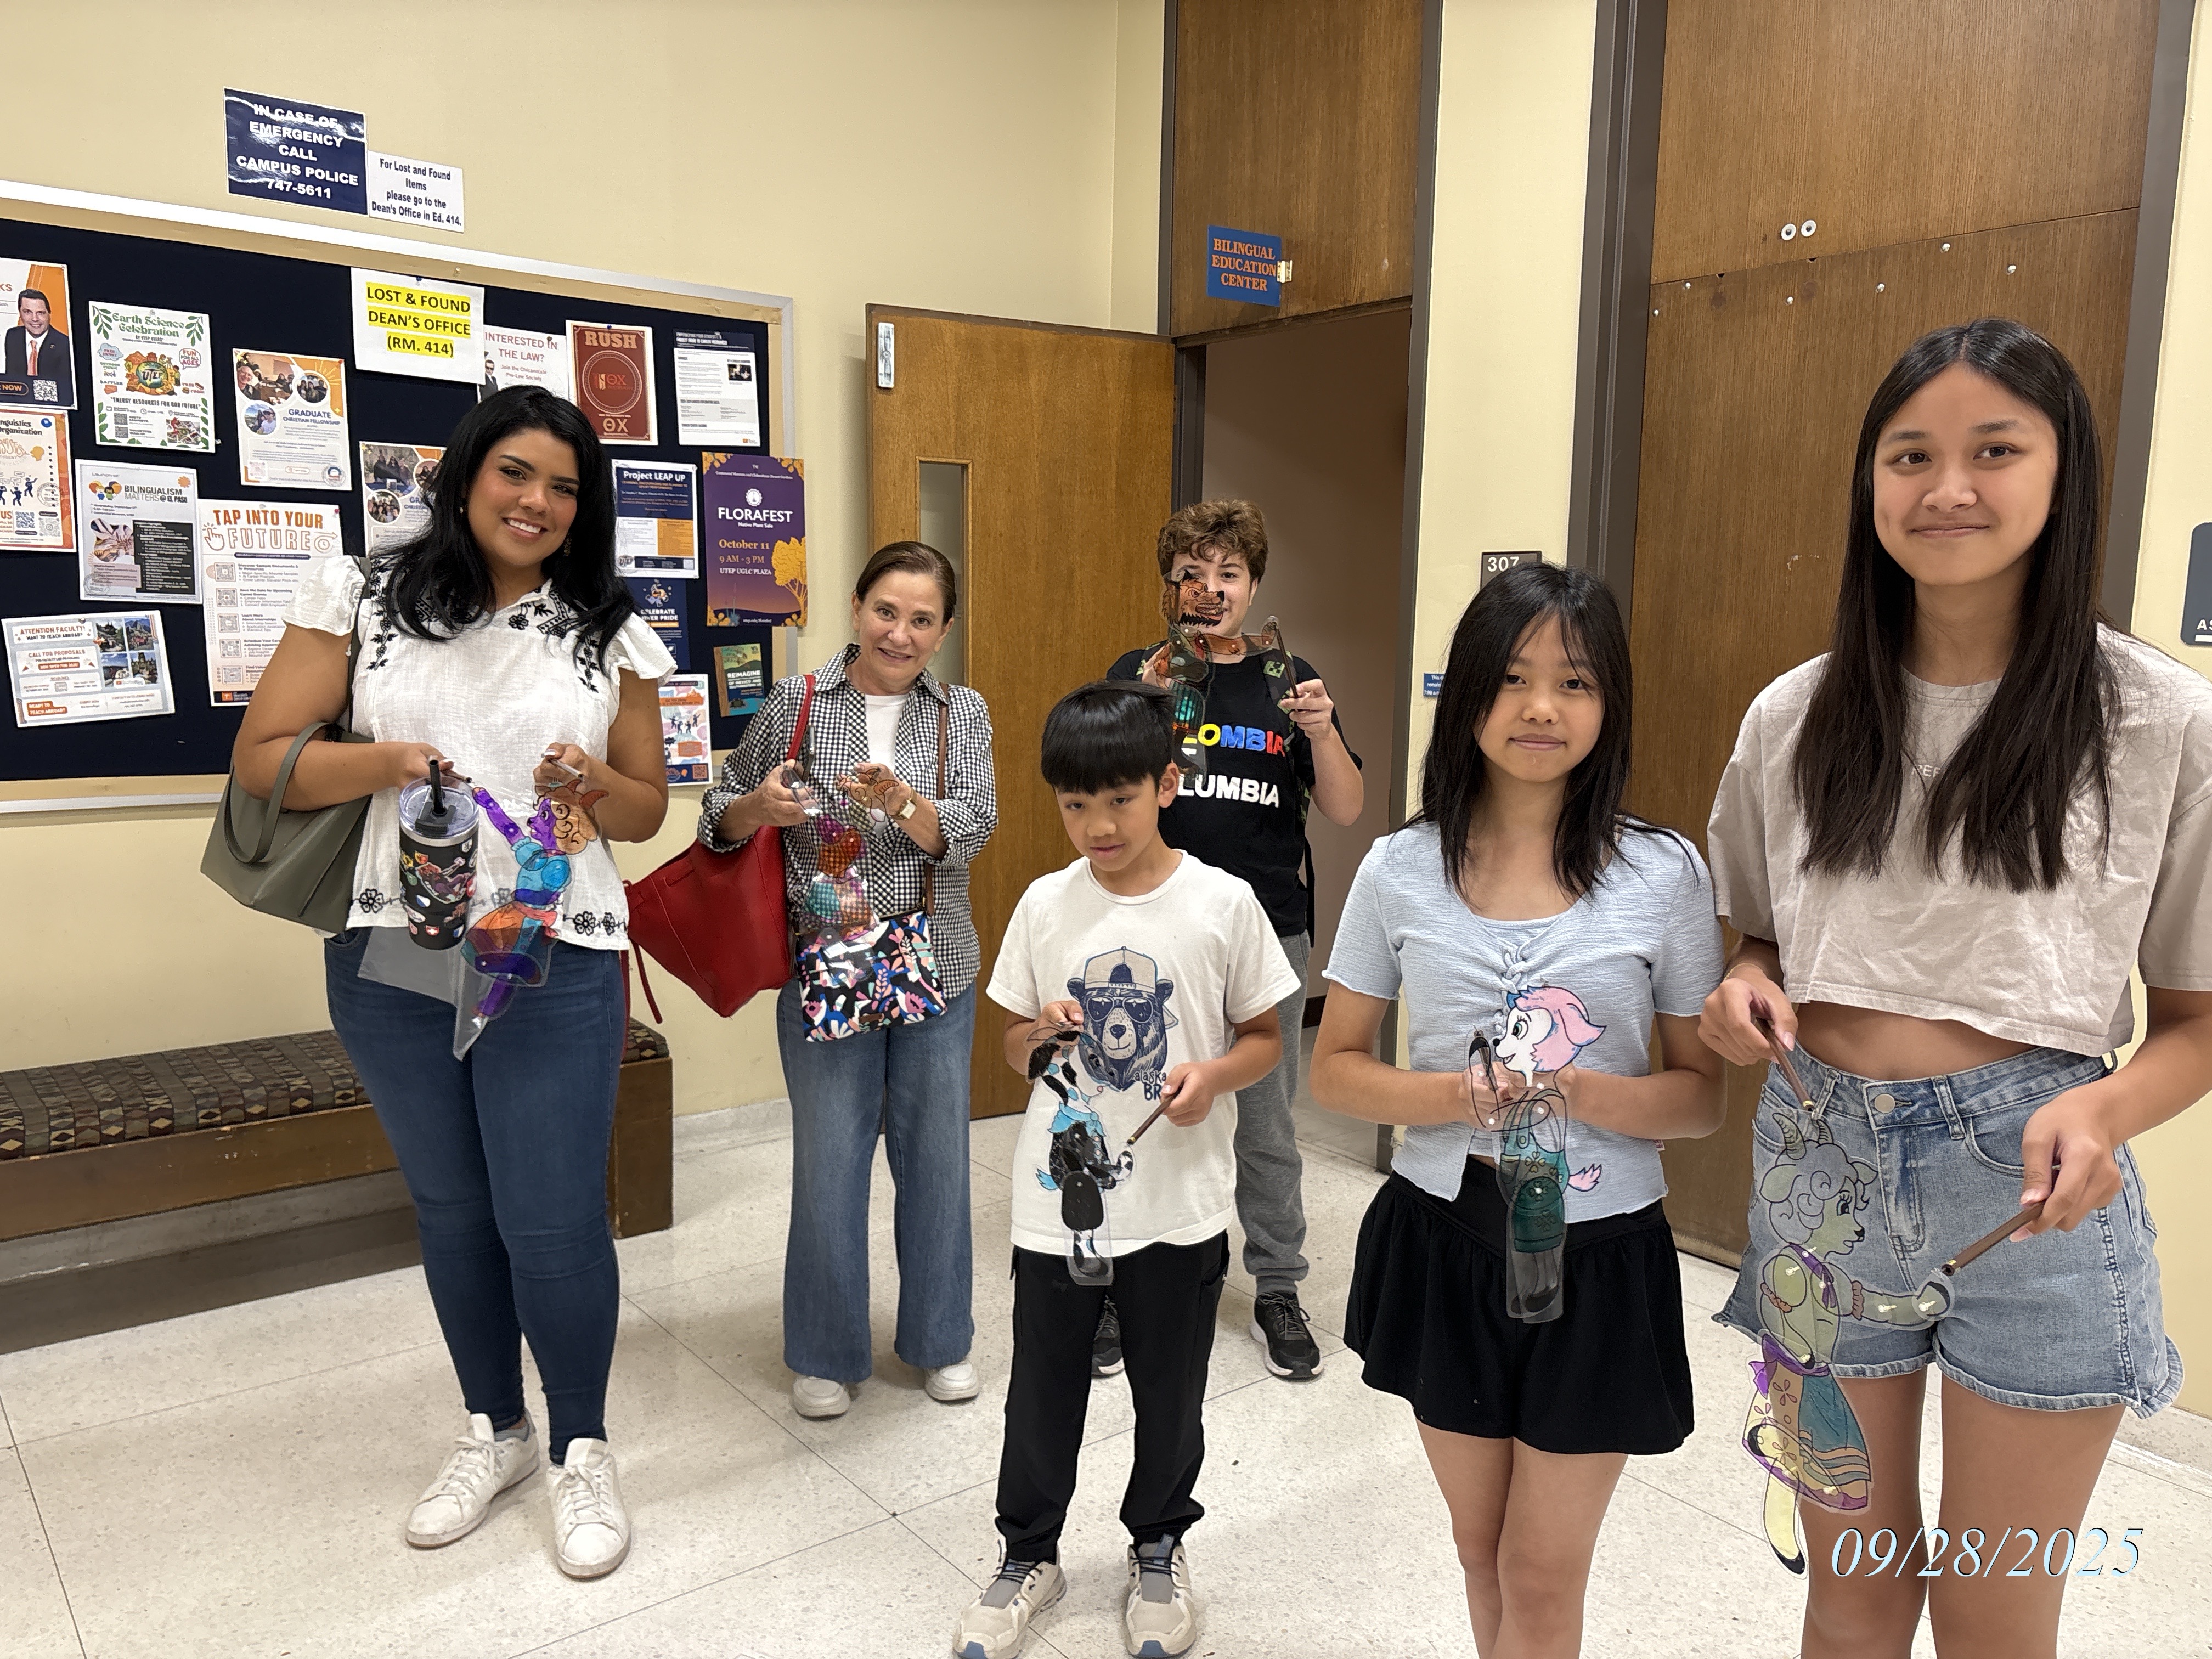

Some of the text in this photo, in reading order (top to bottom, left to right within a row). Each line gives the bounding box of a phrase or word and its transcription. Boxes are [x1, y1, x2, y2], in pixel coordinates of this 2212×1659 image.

[254, 104, 338, 128] IN CASE OF
[249, 121, 343, 148] EMERGENCY
[278, 145, 318, 161] CALL
[236, 155, 358, 186] CAMPUS POLICE
[380, 158, 451, 180] For Lost and Found
[267, 179, 331, 199] 747-5611
[405, 178, 427, 190] Items
[386, 190, 447, 208] please go to the
[371, 201, 462, 226] Dean's Office in Ed. 414.
[1213, 238, 1276, 261] BILINGUAL
[1211, 254, 1277, 277] EDUCATION
[1221, 273, 1268, 292] CENTER
[367, 286, 470, 313] LOST & FOUND
[112, 312, 185, 329] Earth Science
[369, 311, 471, 336] DEAN’S OFFICE
[119, 323, 179, 337] Celebration
[387, 335, 454, 358] (RM. 414)
[485, 331, 558, 351] INTERESTED IN
[584, 330, 637, 349] RUSH
[498, 348, 545, 363] THE LAW?
[132, 398, 160, 407] RESOURCES
[288, 409, 331, 419] GRADUATE
[623, 471, 686, 482] Project LEAP UP
[124, 485, 183, 495] BILINGUALISM
[0, 510, 12, 519] US
[212, 509, 323, 529] TAP INTO YOUR
[718, 507, 793, 523] FLORAFEST
[228, 528, 311, 551] FUTURE
[719, 539, 759, 549] October
[719, 555, 725, 563] 9
[746, 556, 751, 565] 3
[752, 555, 765, 563] PM
[1487, 556, 1520, 572] 307
[727, 670, 761, 679] REIMAGINE
